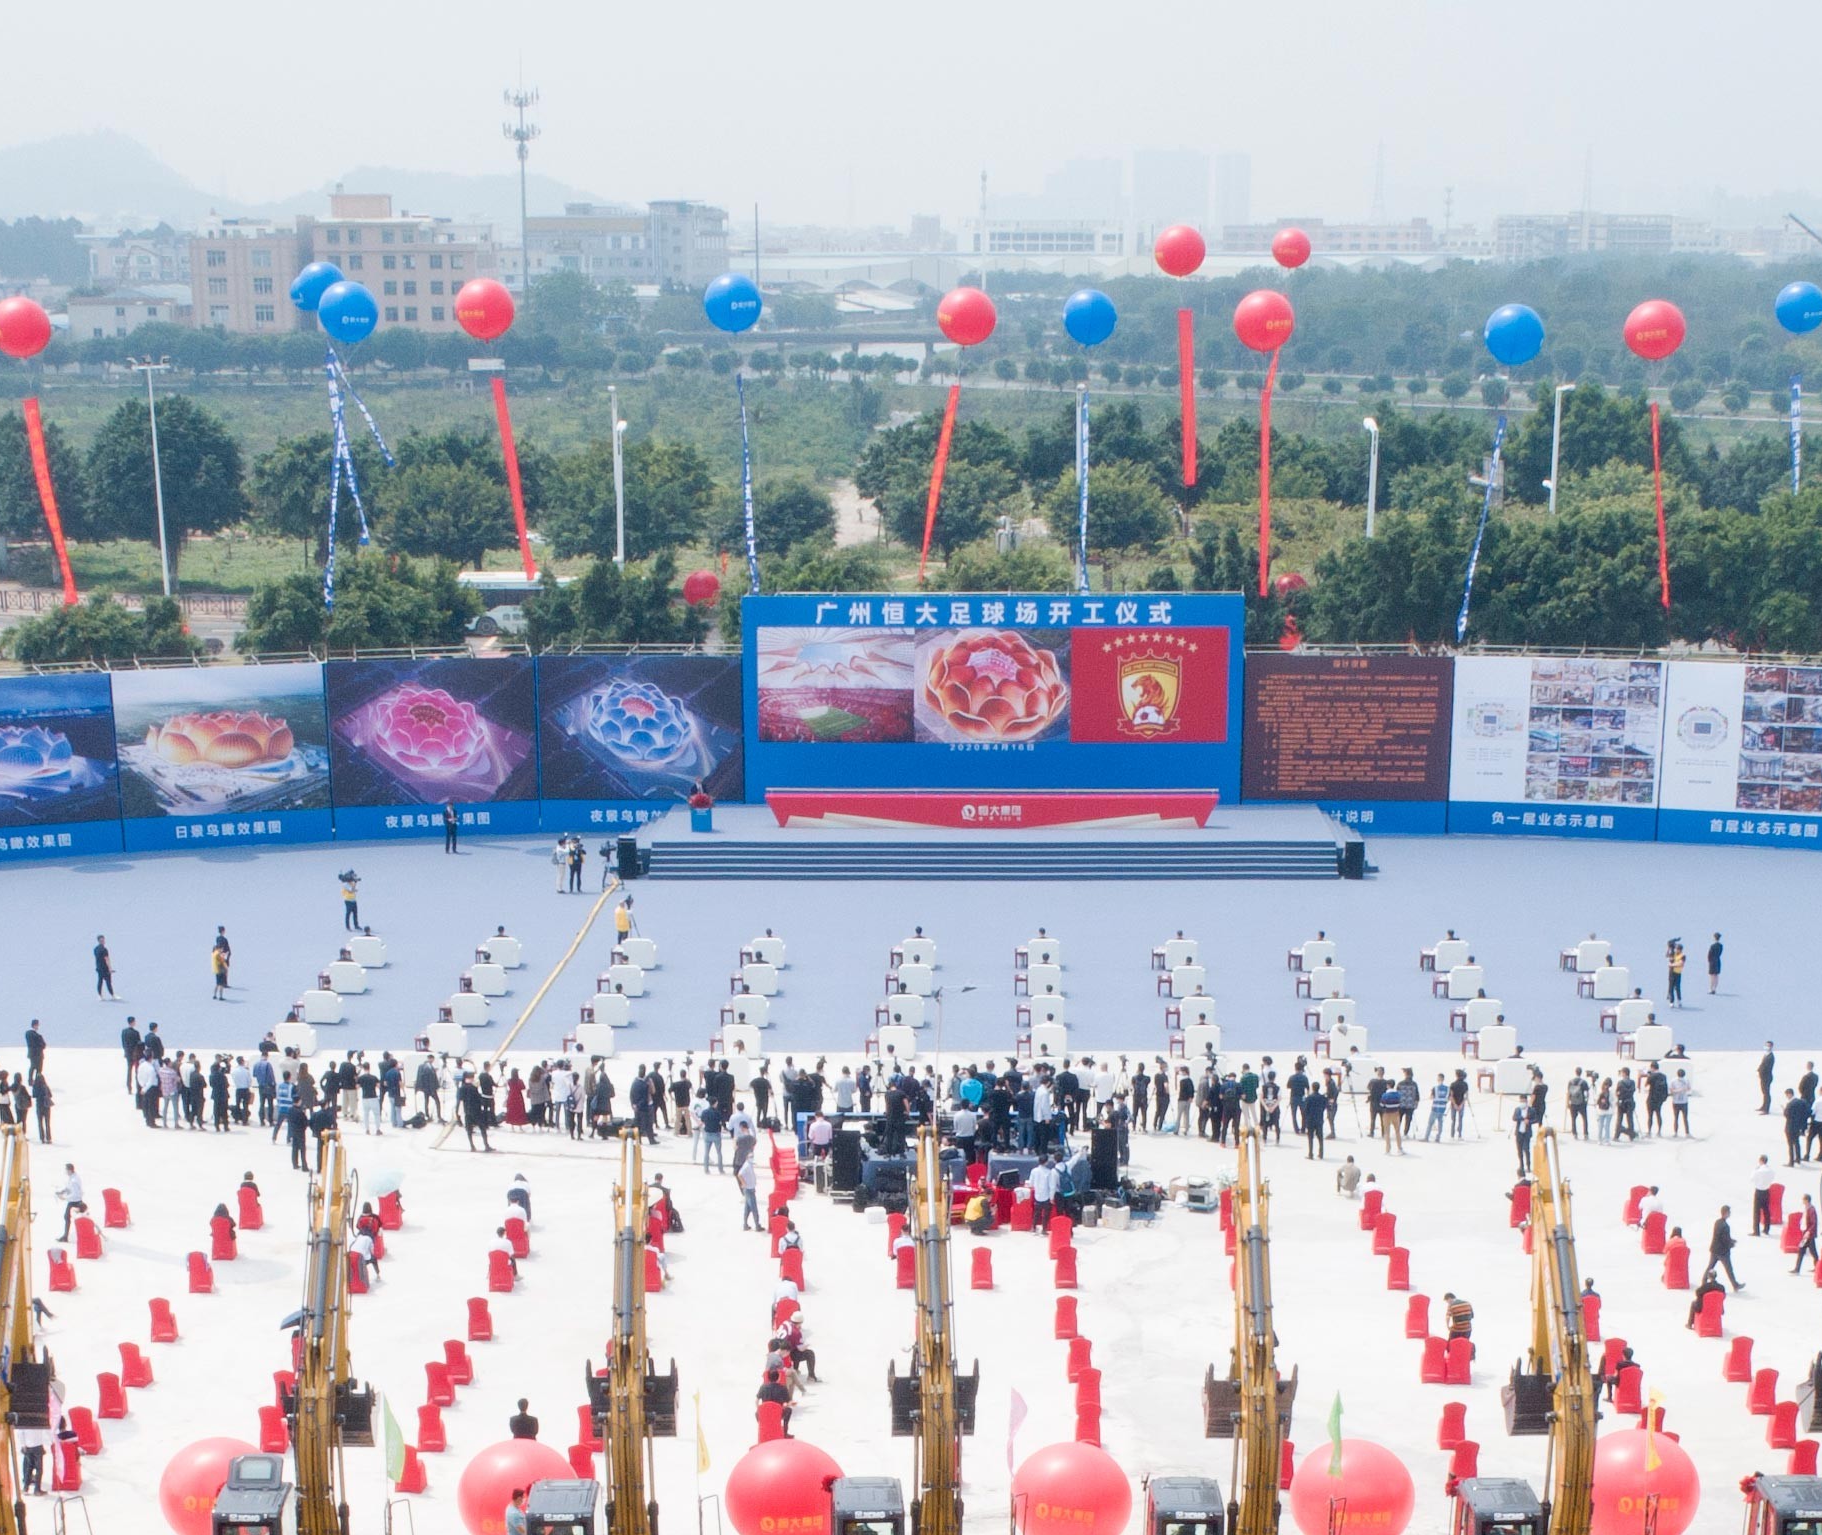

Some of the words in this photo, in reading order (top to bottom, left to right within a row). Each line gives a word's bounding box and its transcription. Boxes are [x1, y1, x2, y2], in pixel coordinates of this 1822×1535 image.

[815, 602, 1172, 625] 广州恒大足球场开工仪式
[176, 819, 282, 839] 日景鸟瞰效果图
[385, 811, 490, 829] 夜景鸟瞰果图
[1492, 811, 1614, 830] 负一层业态示意图
[1710, 819, 1818, 838] 首层业态示意图
